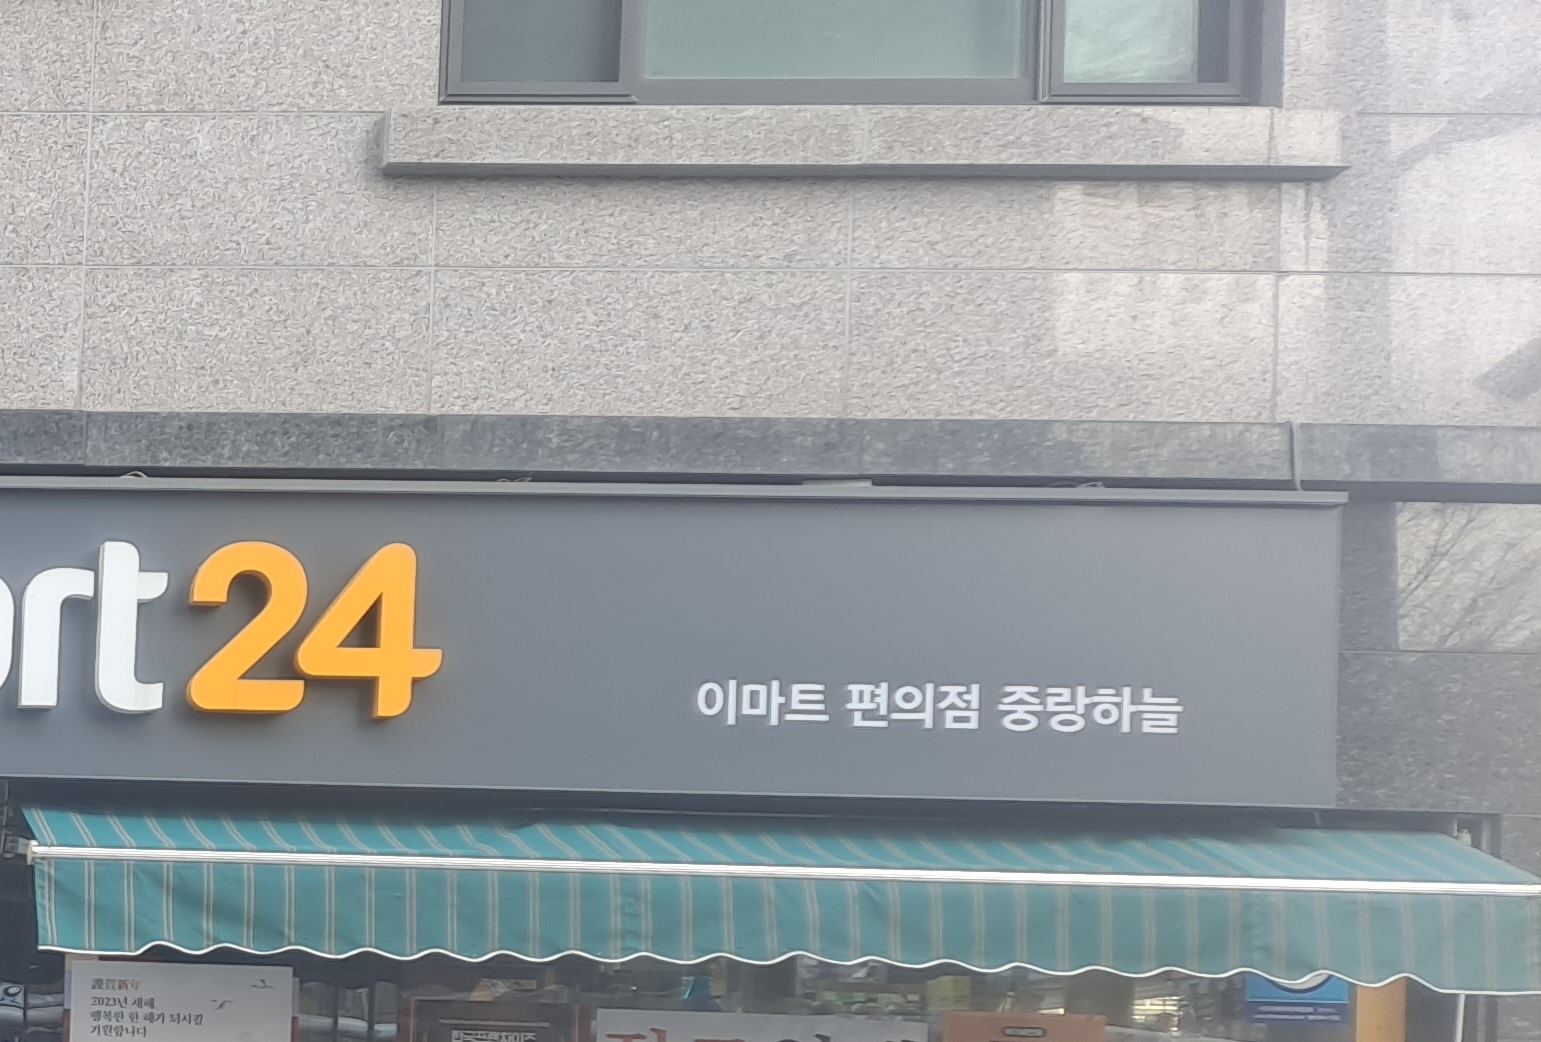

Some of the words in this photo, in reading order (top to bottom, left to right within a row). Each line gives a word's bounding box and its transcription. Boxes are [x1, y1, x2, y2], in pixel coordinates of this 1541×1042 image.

[695, 679, 830, 727] 이마트
[844, 679, 982, 734] 편의점
[998, 684, 1184, 735] 중랑하늘
[90, 996, 129, 1008] 2023년
[90, 1011, 125, 1024] 행복한
[129, 1012, 139, 1023] 한
[143, 1013, 166, 1024] 해가
[169, 1014, 204, 1026] 되시길
[89, 1025, 148, 1038] 기원합니다
